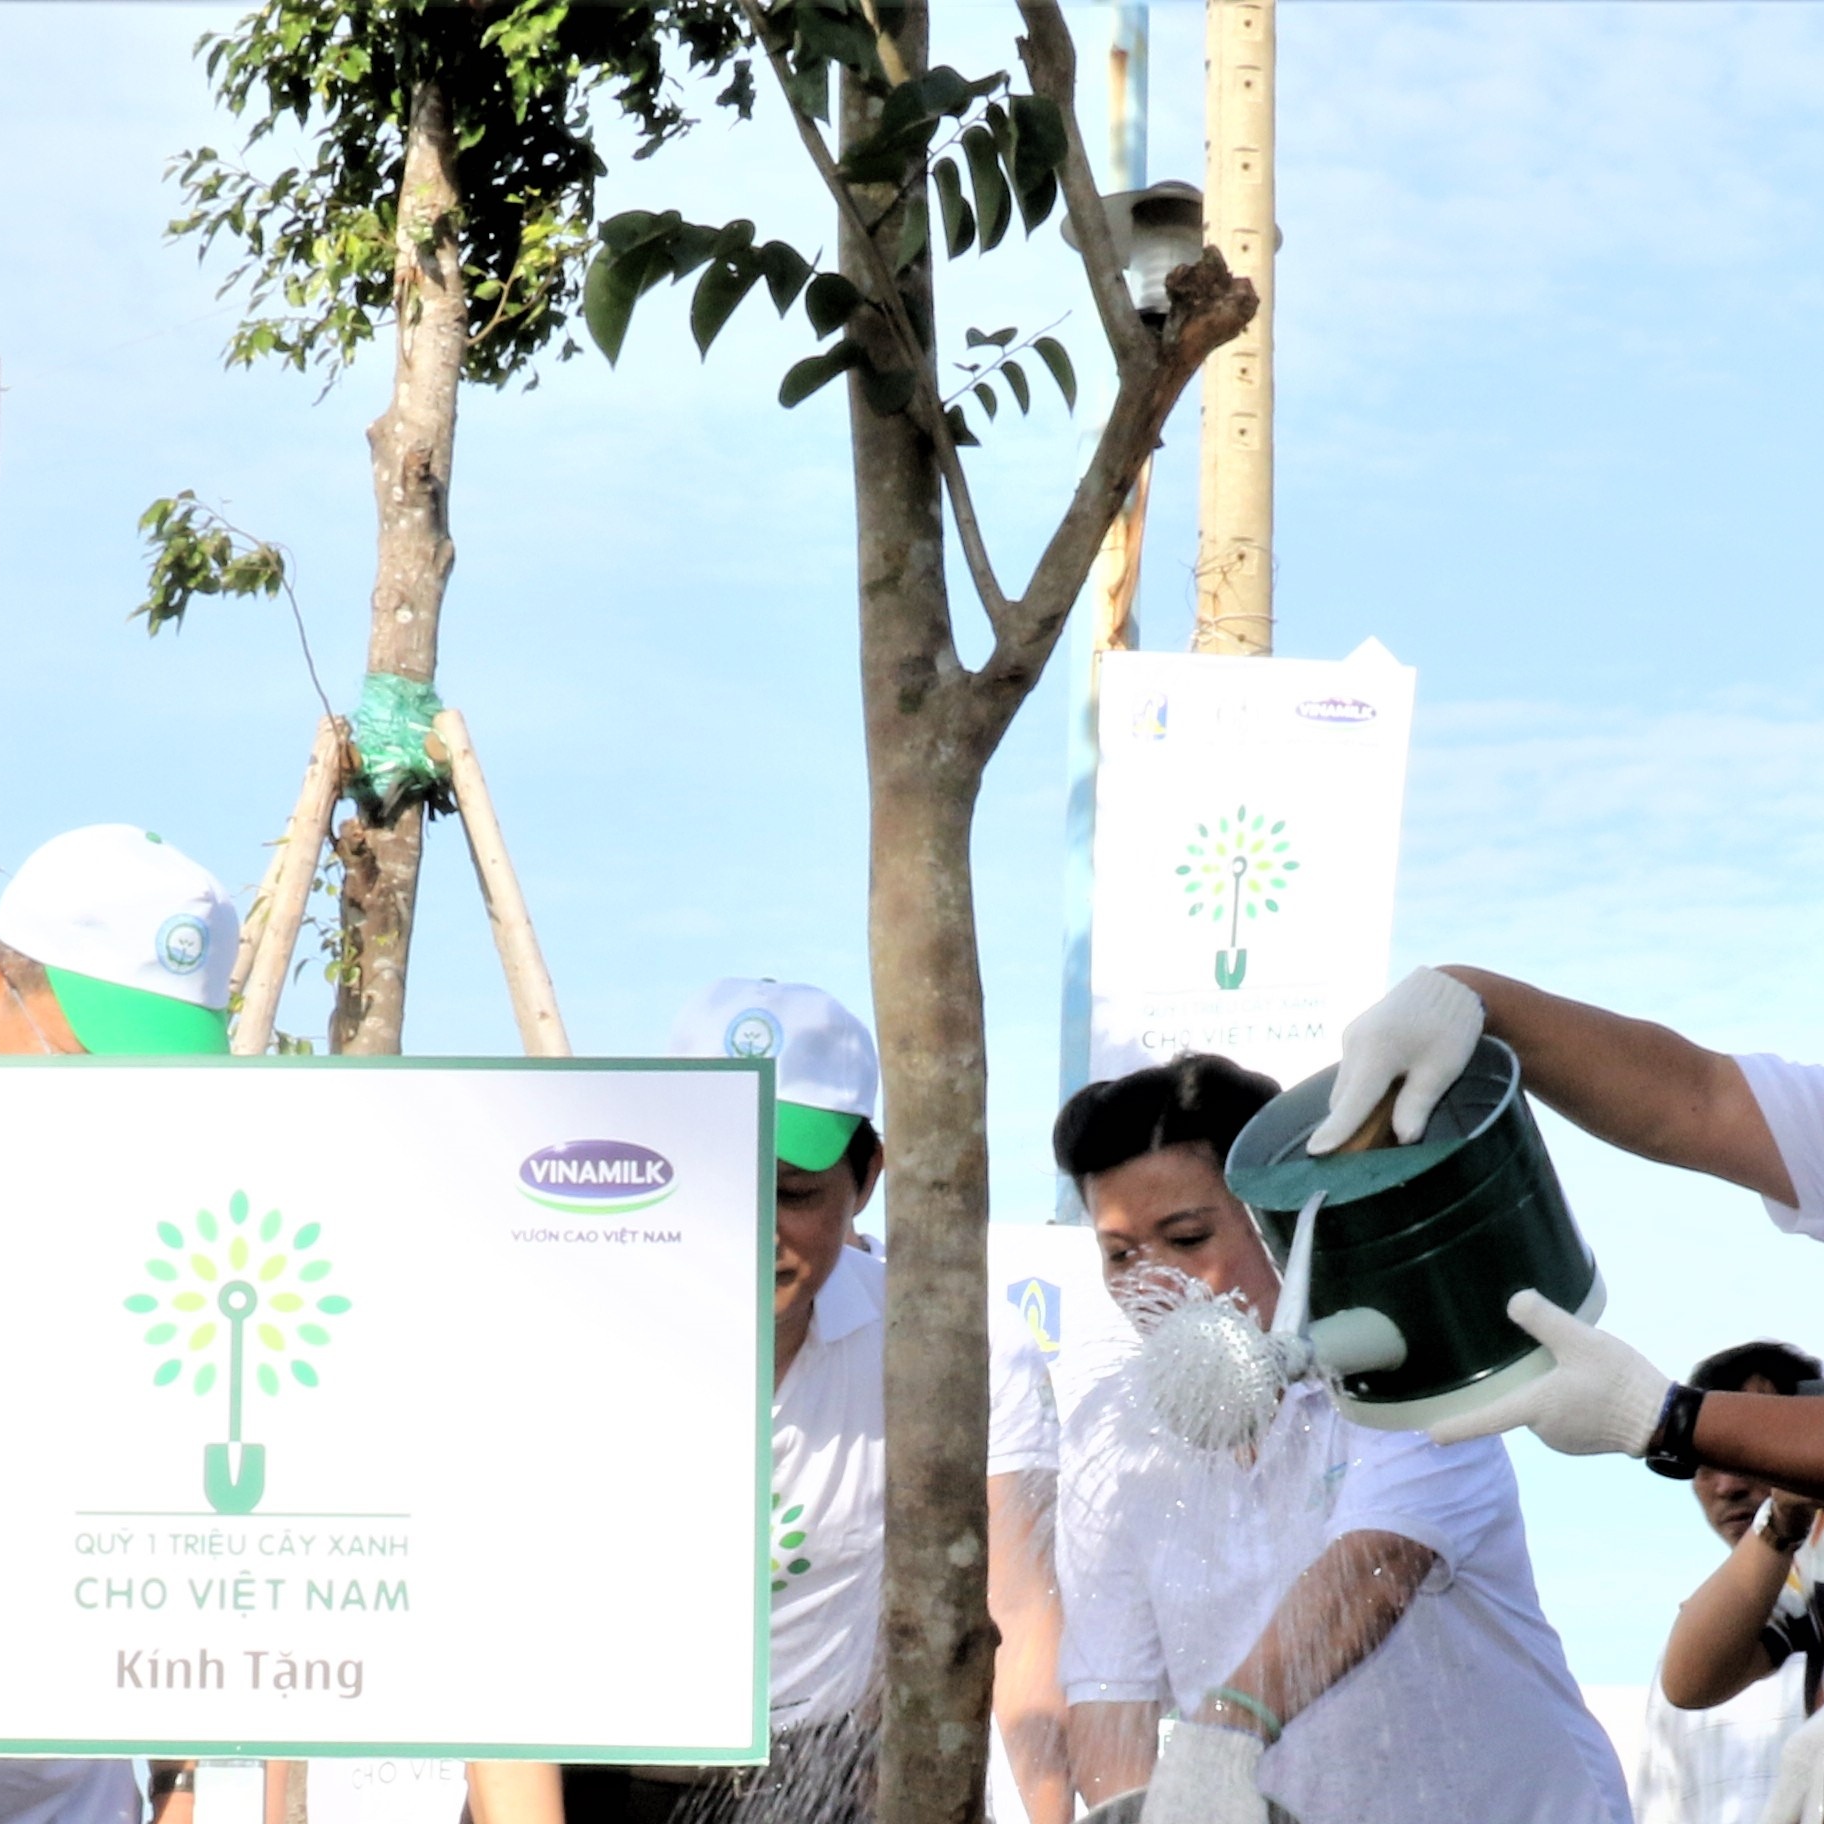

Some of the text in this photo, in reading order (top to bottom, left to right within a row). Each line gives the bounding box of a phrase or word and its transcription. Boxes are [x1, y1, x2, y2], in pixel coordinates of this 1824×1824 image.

[1267, 1023, 1325, 1041] NAM
[529, 1159, 666, 1185] VINAMILK
[563, 1230, 599, 1243] CAO
[602, 1226, 639, 1246] VIỆT
[643, 1230, 682, 1243] NAM
[75, 1527, 409, 1561] QUỸ 1 TRIỆU CÂY XANH
[75, 1569, 410, 1619] CHO VIỆT NAM
[116, 1648, 363, 1699] Kính Tặng
